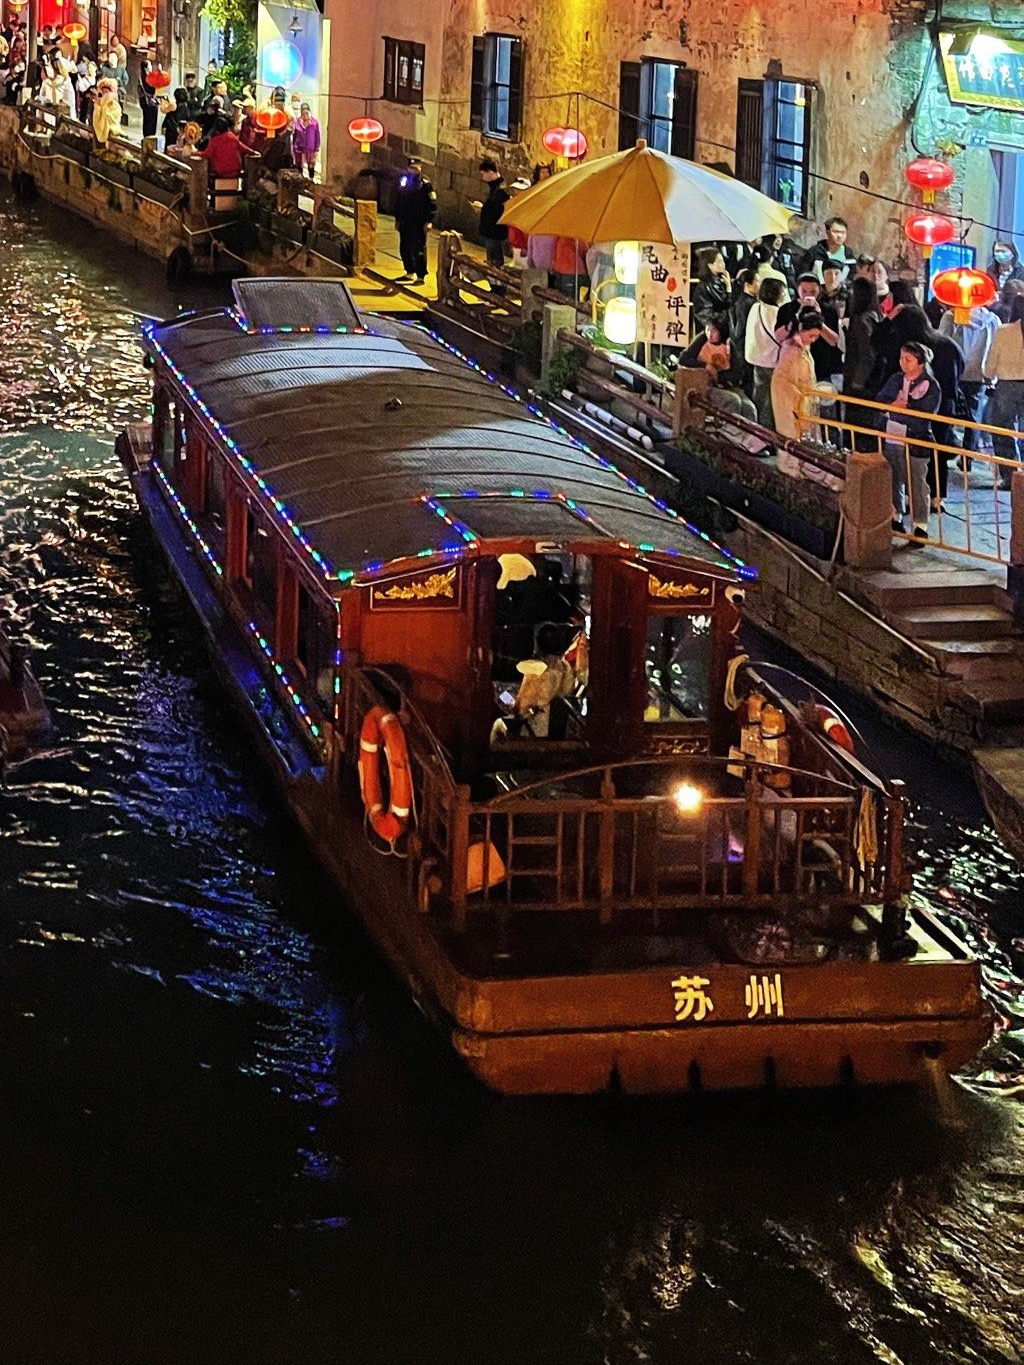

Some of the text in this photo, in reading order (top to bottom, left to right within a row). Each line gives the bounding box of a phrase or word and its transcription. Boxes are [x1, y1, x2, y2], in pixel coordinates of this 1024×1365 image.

[642, 245, 669, 283] 昆曲
[665, 295, 687, 342] 评弹
[671, 973, 784, 1021] 苏州
